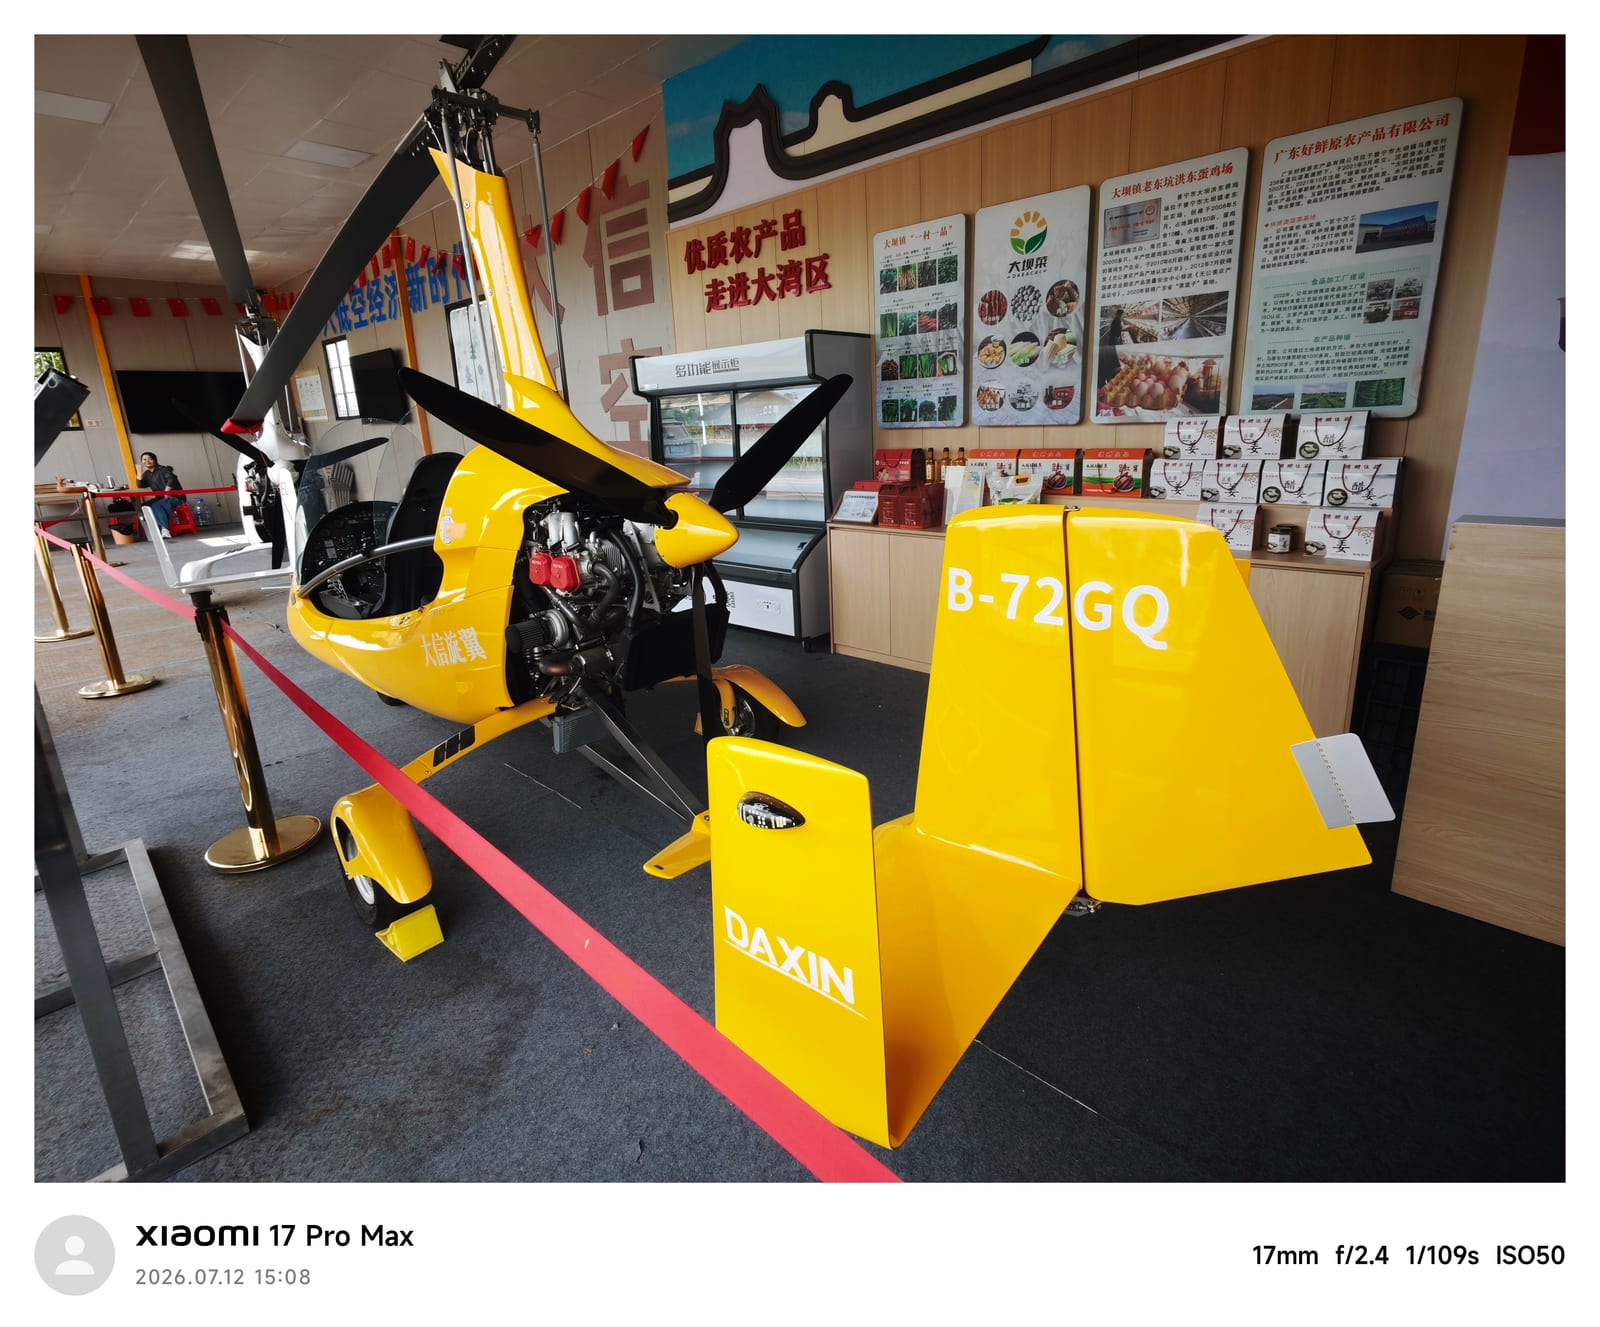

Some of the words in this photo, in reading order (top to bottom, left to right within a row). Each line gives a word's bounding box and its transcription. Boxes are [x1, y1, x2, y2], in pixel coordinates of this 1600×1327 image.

[1274, 112, 1451, 162] 广东好鲜原农产品有限公司
[1111, 161, 1234, 200] 大坝镇老东坑洪东蛋鸡场
[685, 209, 806, 275] 优质农产品
[705, 253, 832, 313] 走进大湾区
[1008, 255, 1049, 274] 大坝菜
[1311, 272, 1365, 285] 食品加工厂建设
[1313, 333, 1351, 342] 农产品种植
[675, 358, 740, 378] 多功能展示柜
[1332, 538, 1351, 554] 姜
[948, 567, 1171, 650] B-72GQ
[420, 626, 488, 669] 大信旋翼
[724, 905, 855, 1006] DAXIN
